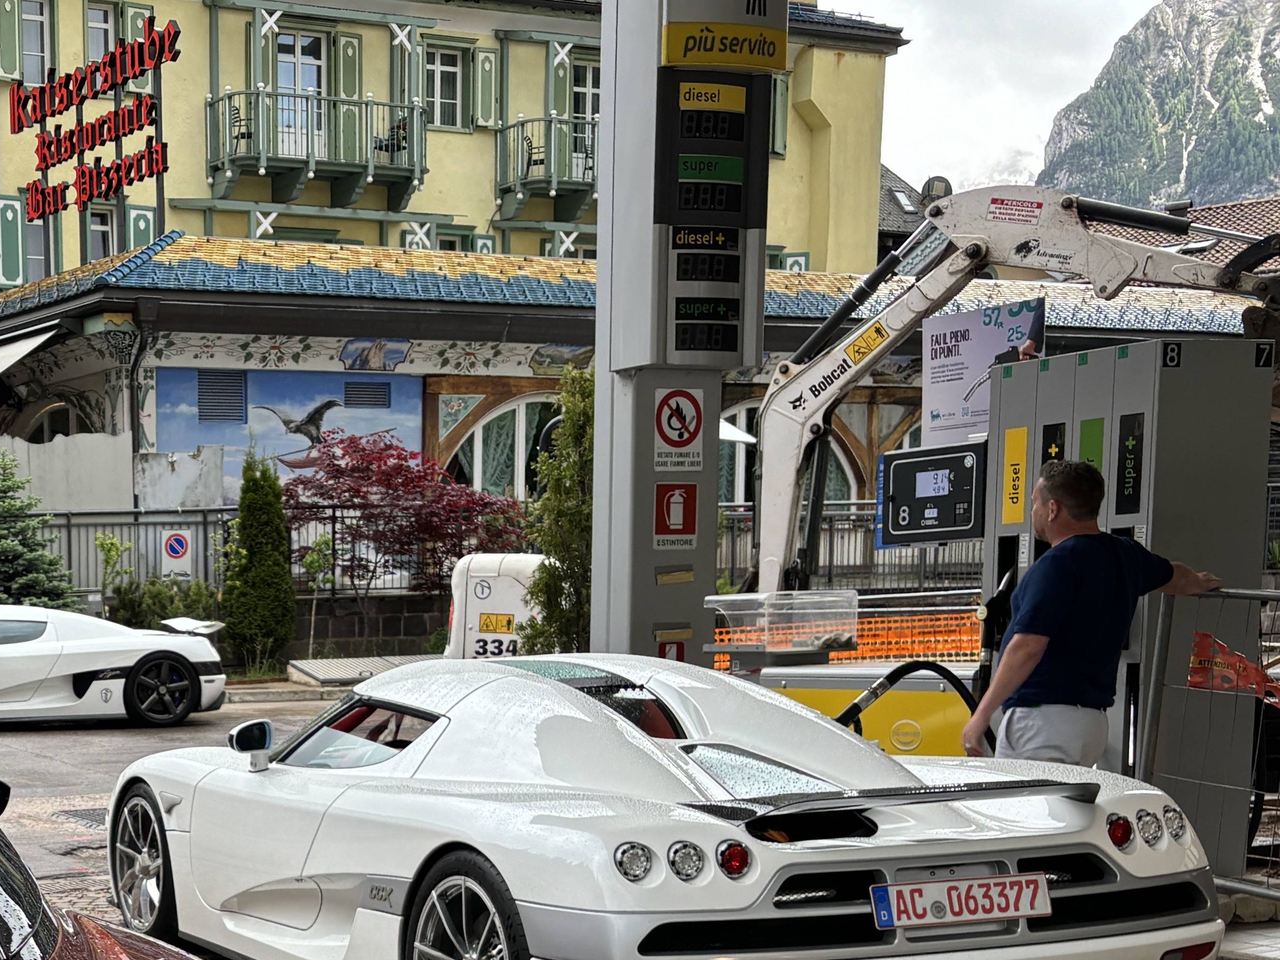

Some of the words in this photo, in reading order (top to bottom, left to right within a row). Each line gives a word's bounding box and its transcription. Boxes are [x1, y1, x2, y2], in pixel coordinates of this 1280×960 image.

[683, 25, 716, 58] più
[718, 33, 776, 58] servito
[9, 16, 181, 134] Kaiserstube
[683, 87, 720, 103] diesel
[35, 93, 157, 171] Ristorante
[682, 160, 719, 174] super
[26, 179, 69, 222] Bar
[71, 136, 169, 211] Pizzeria
[1003, 200, 1037, 208] PERICOLO
[930, 332, 941, 347] FAI
[942, 332, 949, 345] IL
[950, 328, 972, 343] PIENO.
[930, 347, 938, 360] DI
[939, 344, 962, 359] PUNTI.
[1166, 345, 1178, 366] 8
[1258, 345, 1270, 366] 7
[809, 358, 852, 398] Bobcat
[1008, 463, 1020, 504] diesel
[899, 506, 909, 525] 8
[656, 539, 693, 547] ESTINTORE
[474, 638, 518, 656] 334
[369, 884, 393, 908] CCX
[894, 888, 927, 921] AC
[946, 879, 1039, 917] 063377
[881, 911, 888, 920] D
